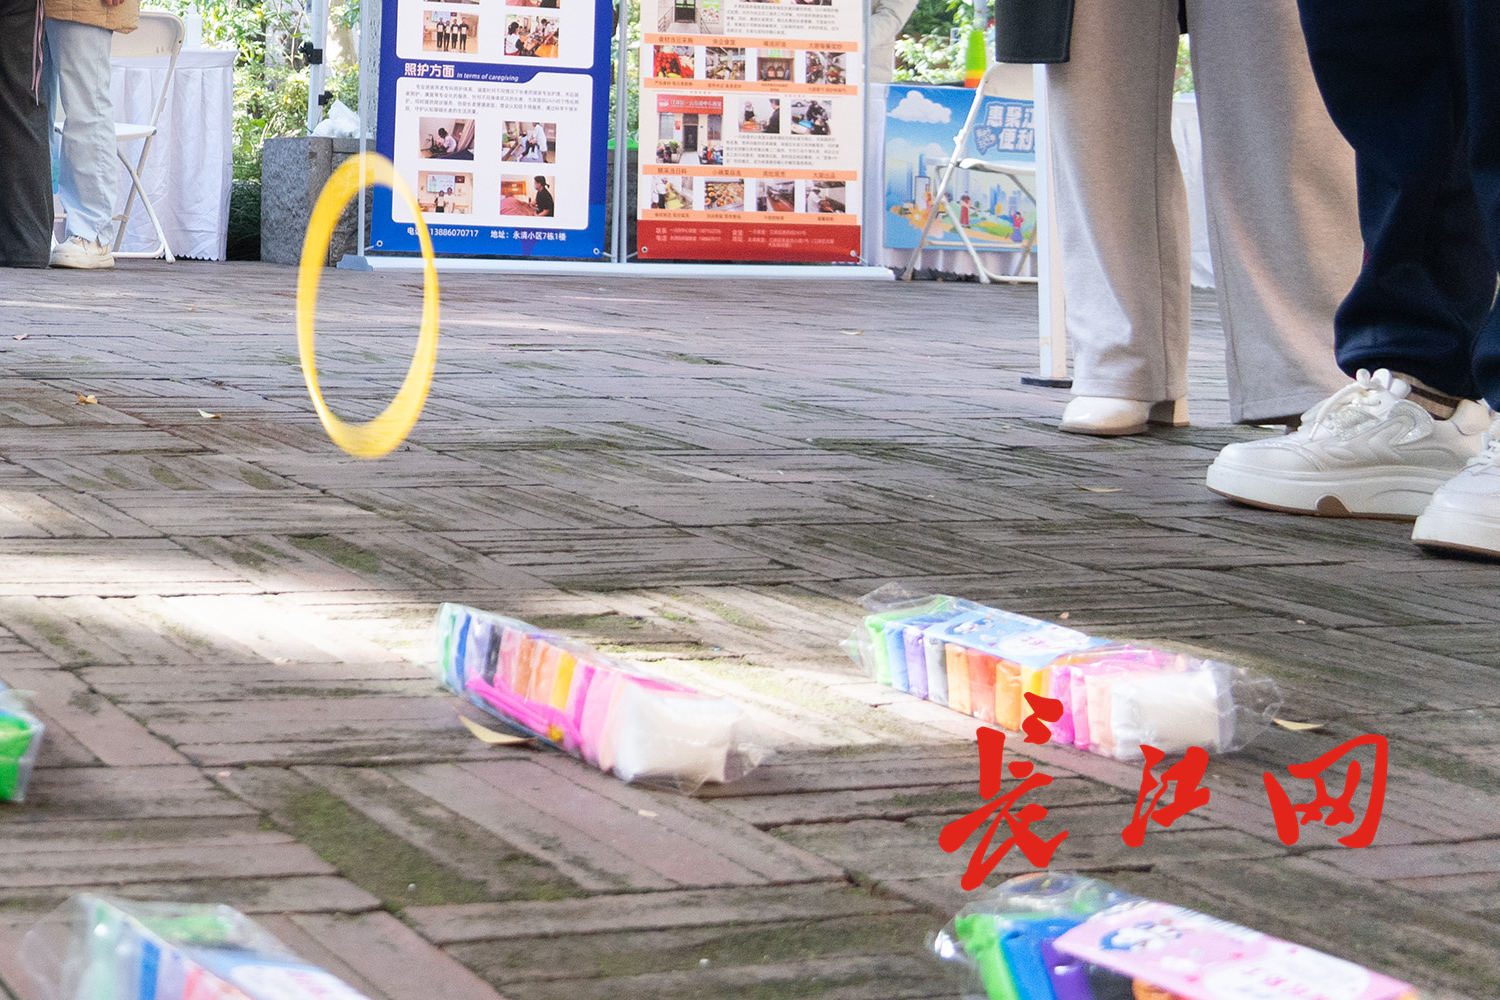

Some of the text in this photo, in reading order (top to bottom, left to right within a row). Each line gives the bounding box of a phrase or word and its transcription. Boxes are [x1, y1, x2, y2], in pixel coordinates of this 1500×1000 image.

[404, 62, 455, 78] 照护方面
[463, 72, 480, 80] terms
[480, 72, 488, 81] of
[488, 73, 519, 83] caregiving
[999, 128, 1033, 151] 便利
[407, 227, 479, 238] 电13886070717
